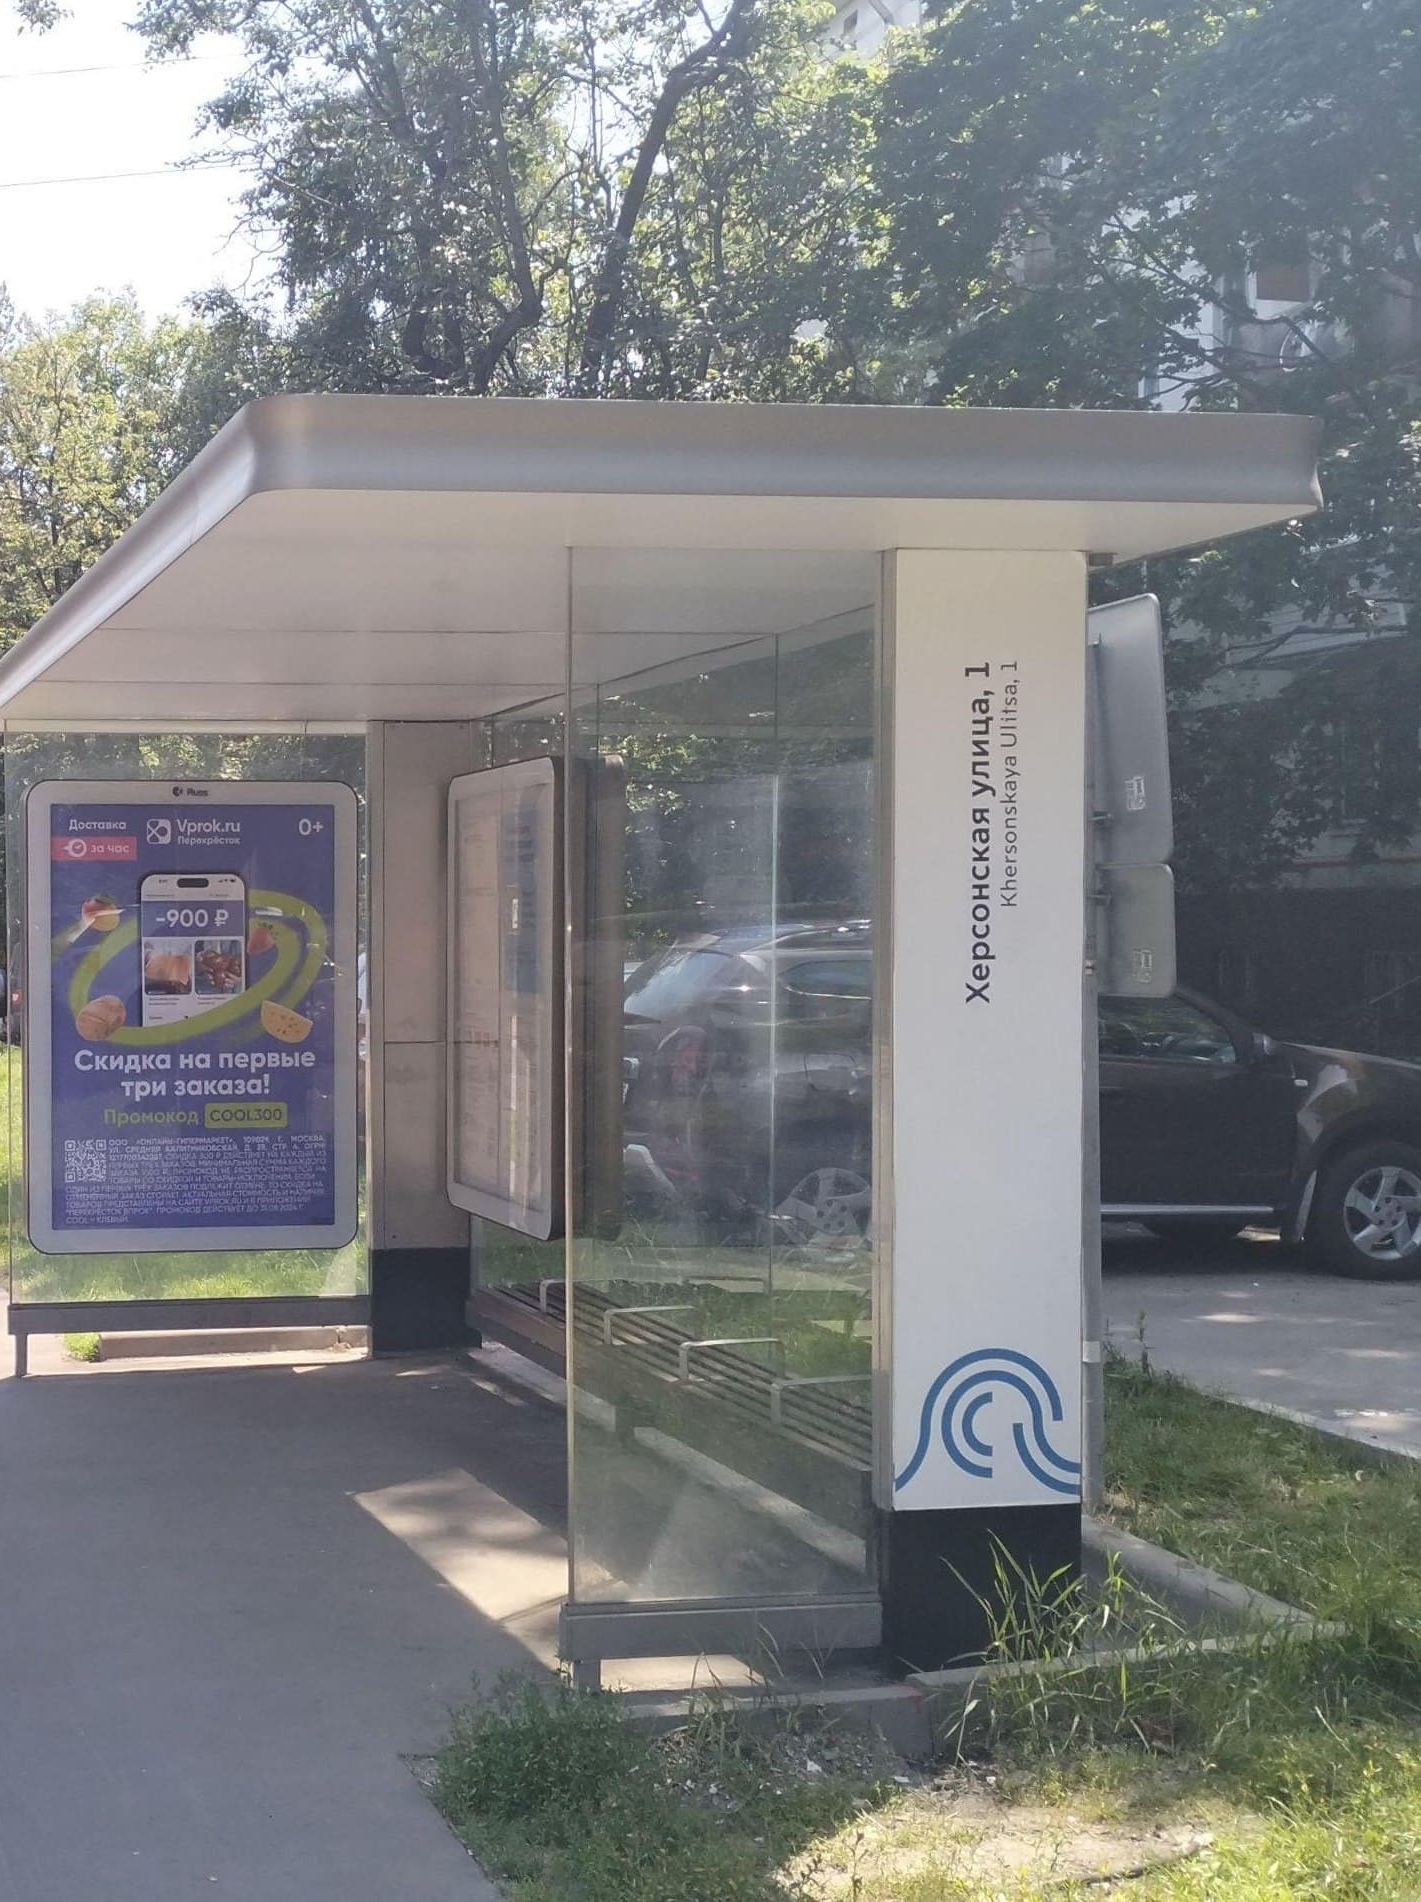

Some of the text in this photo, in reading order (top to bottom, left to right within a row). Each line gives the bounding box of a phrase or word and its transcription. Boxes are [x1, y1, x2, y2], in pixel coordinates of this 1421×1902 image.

[1000, 660, 1021, 908] Khersonskaya Ulitsa, 1
[68, 819, 127, 831] Доставка
[177, 819, 241, 836] Vprok.ru
[298, 818, 324, 836] 0+
[964, 662, 996, 1004] Херсонская улица, 1
[90, 844, 130, 853] за час
[74, 1049, 316, 1074] Скидка на первые
[120, 1073, 270, 1102] три заказа!
[104, 1108, 283, 1127] Промокод COOL300
